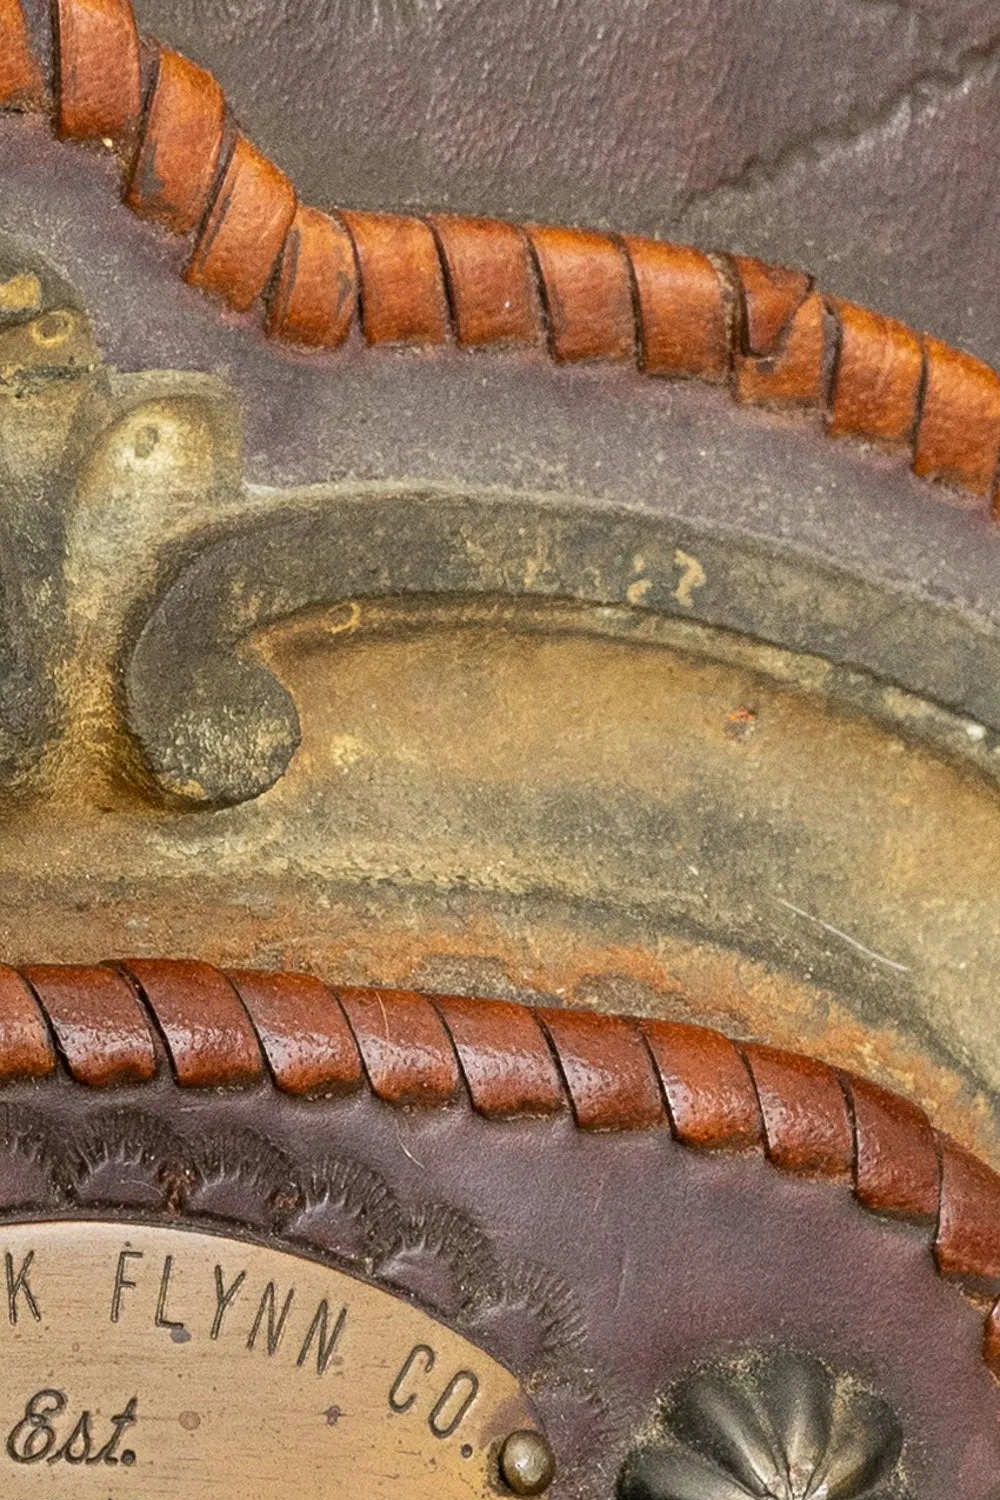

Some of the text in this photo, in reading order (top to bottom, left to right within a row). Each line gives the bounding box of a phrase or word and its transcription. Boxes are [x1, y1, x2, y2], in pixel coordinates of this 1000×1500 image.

[110, 1250, 347, 1375] FLYNN
[387, 1343, 480, 1458] CO.
[6, 1388, 137, 1466] Est.
